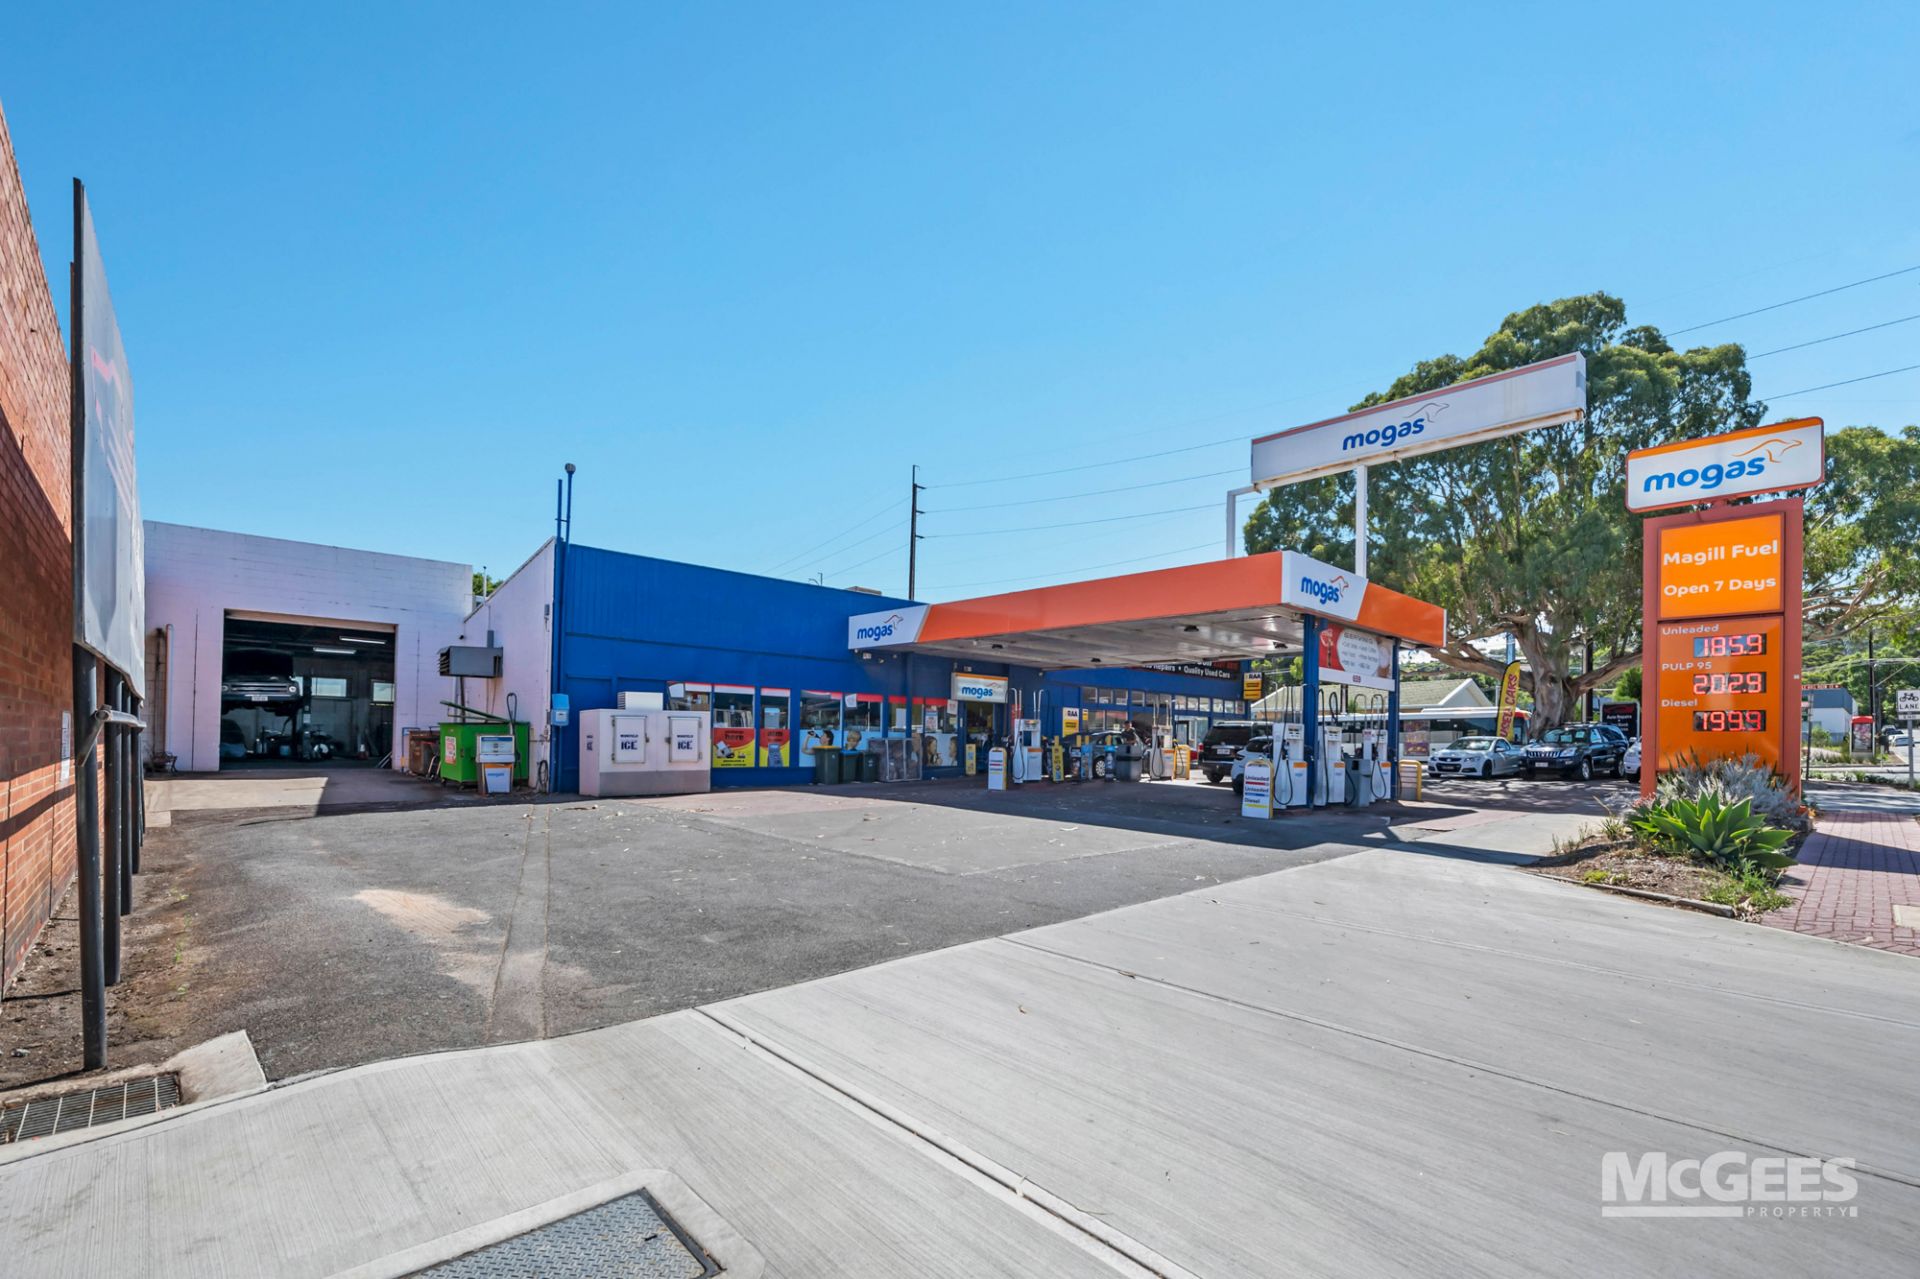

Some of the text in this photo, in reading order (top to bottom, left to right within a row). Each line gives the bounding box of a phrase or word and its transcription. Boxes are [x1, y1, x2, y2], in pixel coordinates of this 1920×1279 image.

[1342, 418, 1425, 451] mogas
[1643, 456, 1765, 492] mogas
[1663, 539, 1778, 566] Magill Fuel
[1301, 576, 1340, 605] mogas
[1664, 578, 1777, 597] Open 7 Days
[857, 624, 894, 641] mogas
[1662, 624, 1720, 636] Unleaded
[1703, 634, 1763, 657] 185.9
[1184, 665, 1204, 677] Quality
[1205, 668, 1218, 677] Used
[1218, 670, 1231, 679] Cars
[1661, 661, 1713, 671] PULP 95
[961, 686, 994, 699] mogas
[1505, 673, 1518, 706] CARS
[1693, 672, 1762, 695] 202.9
[1661, 698, 1698, 708] Diesel
[620, 740, 638, 750] ICE
[677, 740, 693, 750] ICE
